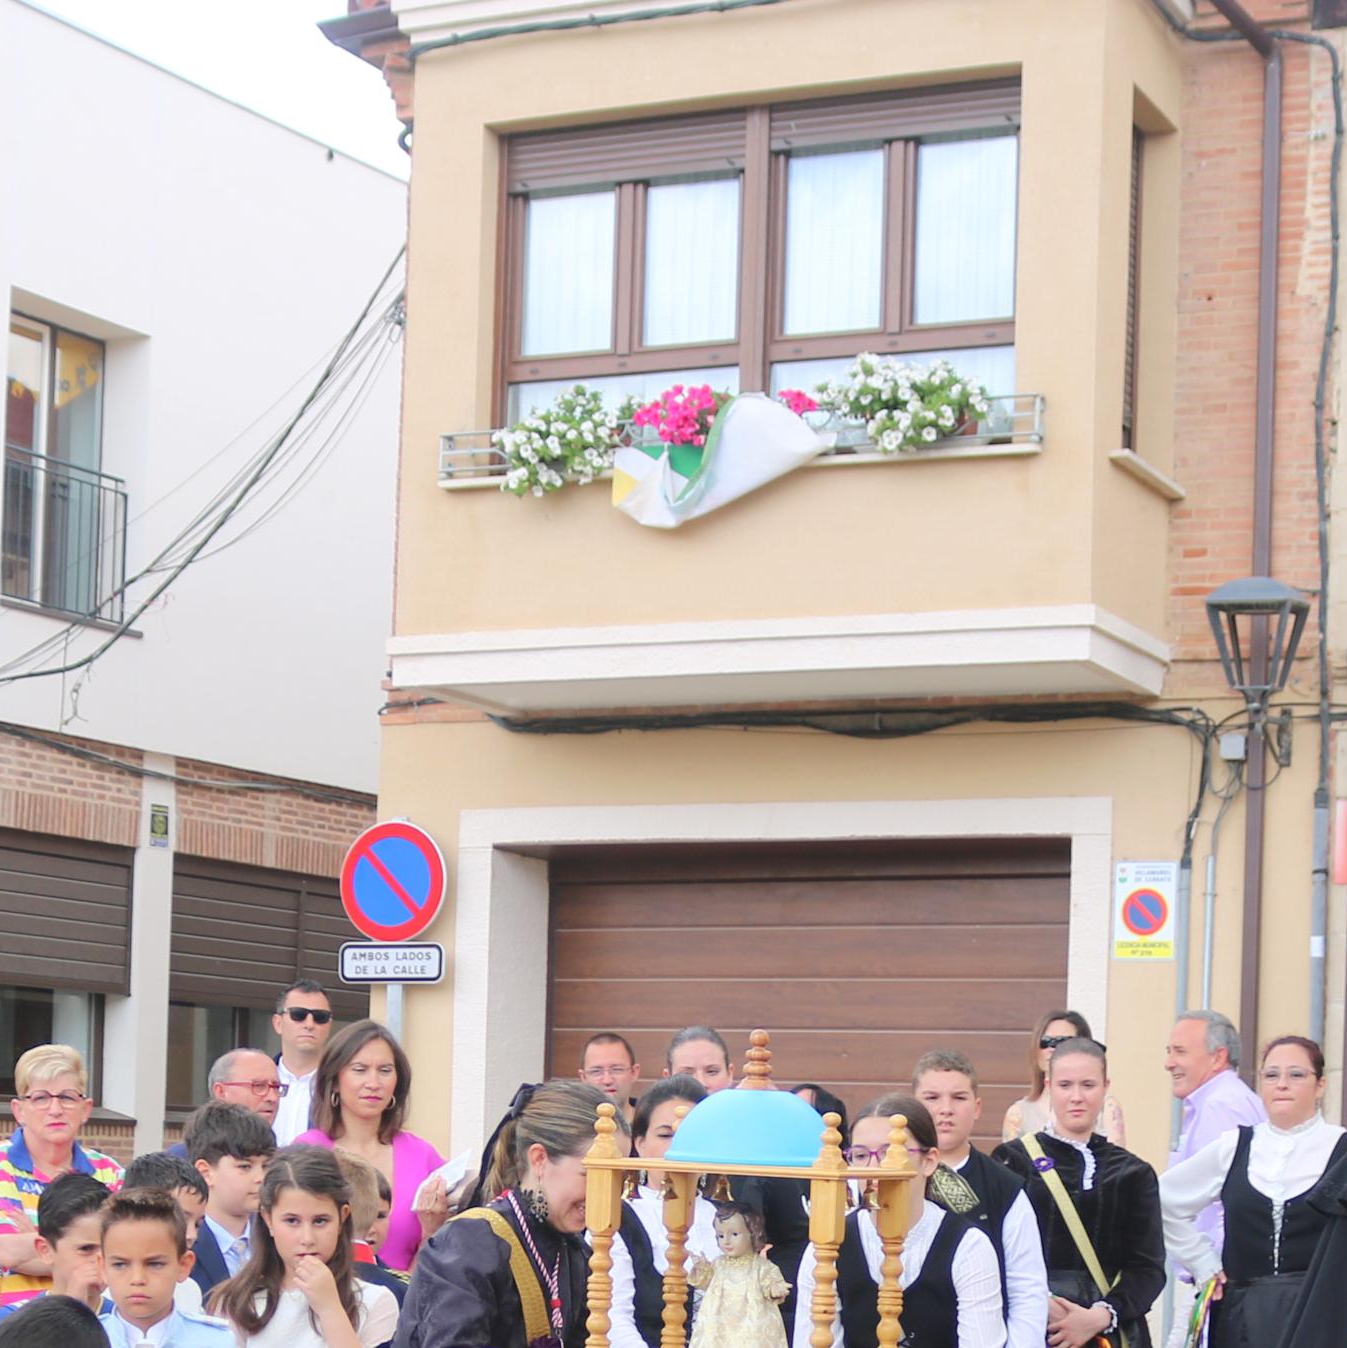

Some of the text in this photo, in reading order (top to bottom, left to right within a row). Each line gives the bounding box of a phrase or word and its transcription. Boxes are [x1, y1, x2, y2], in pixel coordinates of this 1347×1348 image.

[351, 951, 432, 961] AMBOS LADOS
[354, 965, 427, 975] DE LA CALLE
